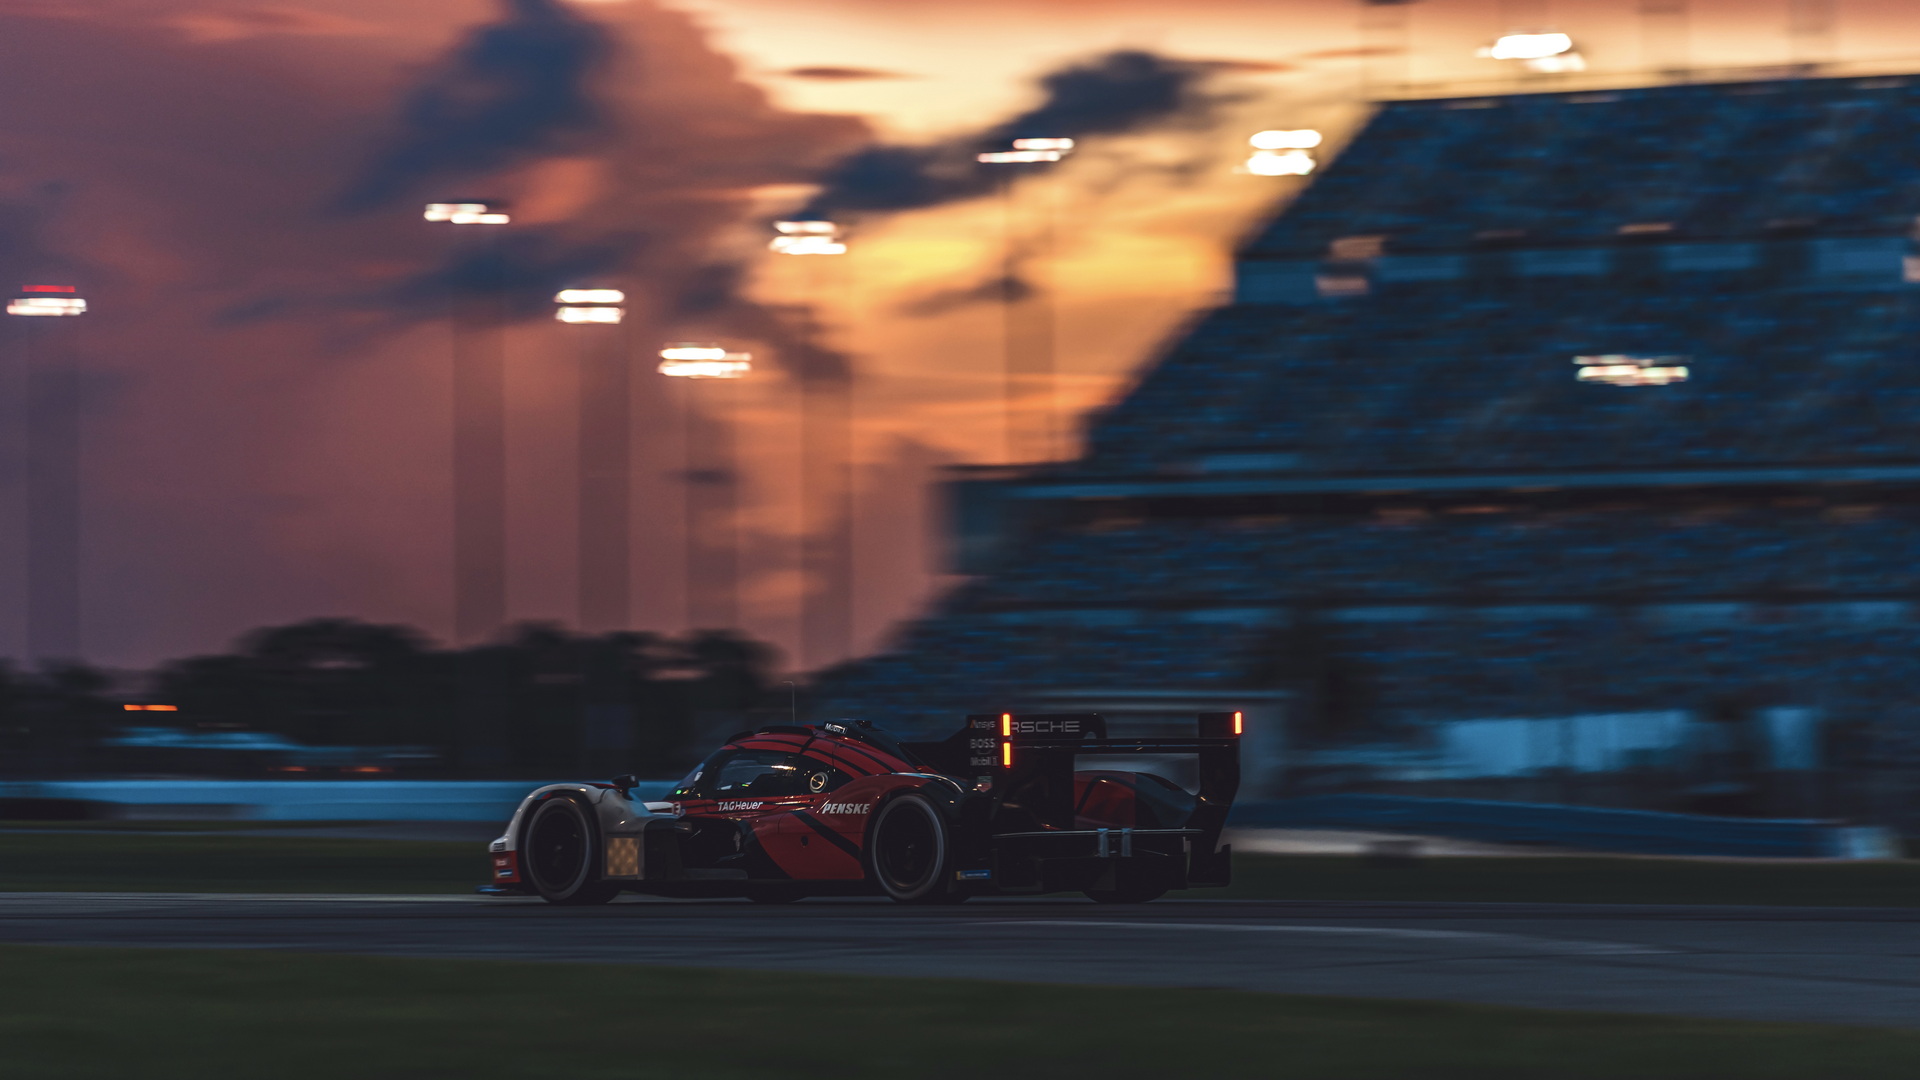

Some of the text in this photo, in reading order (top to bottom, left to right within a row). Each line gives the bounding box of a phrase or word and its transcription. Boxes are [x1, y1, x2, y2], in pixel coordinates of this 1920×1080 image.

[970, 719, 996, 730] Ansys
[1010, 720, 1080, 733] RSCHE
[970, 738, 996, 749] BOSS
[821, 803, 870, 814] PENSKE
